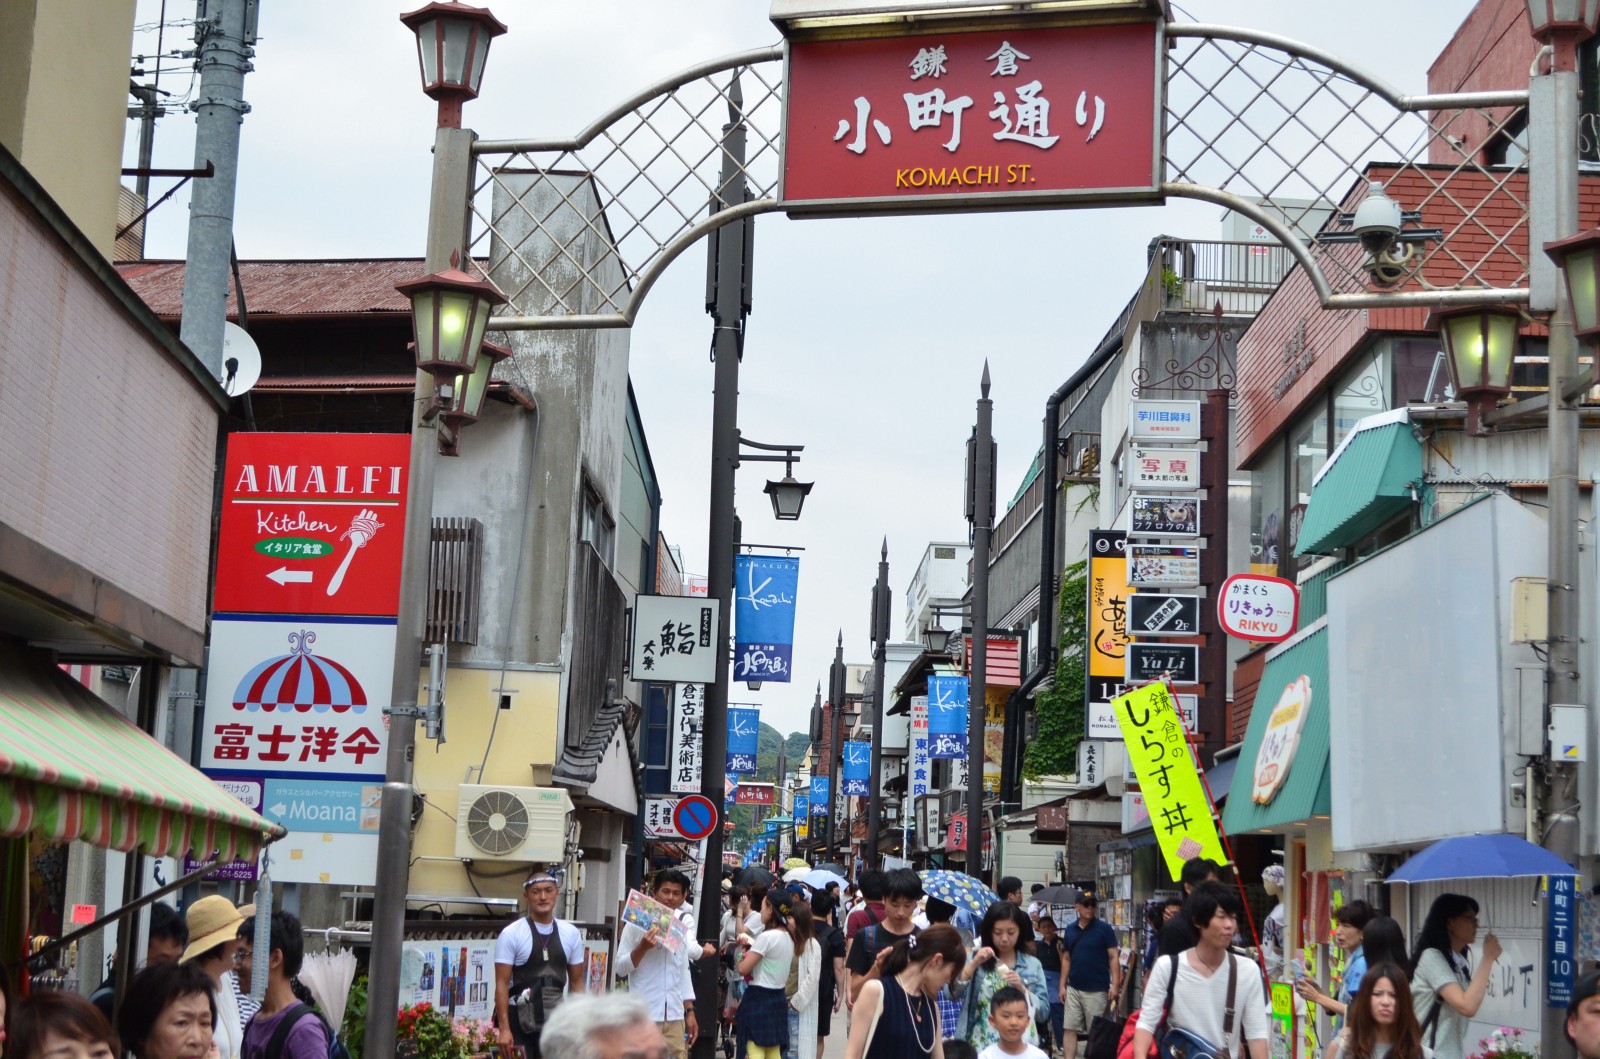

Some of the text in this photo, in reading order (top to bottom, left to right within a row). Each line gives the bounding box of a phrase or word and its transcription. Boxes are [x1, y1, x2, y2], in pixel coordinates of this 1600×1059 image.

[908, 41, 1031, 80] 鎌倉
[833, 80, 1106, 154] 小町通り
[896, 164, 1036, 188] KOMACHI ST.
[1136, 450, 1147, 459] 3F
[1142, 459, 1188, 473] 写真
[234, 465, 402, 494] AMALFI
[1134, 498, 1149, 509] 3F
[257, 509, 337, 535] Kitchen
[1135, 521, 1196, 532] フクロウの森
[264, 542, 322, 554] イタリア食堂
[1233, 583, 1268, 595] かまくら
[1229, 600, 1274, 618] りきゅう
[1174, 619, 1190, 631] 2F
[1238, 618, 1278, 633] RIKYU
[660, 619, 696, 657] 鮨
[1141, 656, 1186, 669] Yu Li
[1150, 690, 1184, 758] 鎌倉の
[914, 738, 928, 795] 東洋食肉
[1125, 699, 1193, 835] しらす丼
[276, 788, 360, 798] ガラスとシルバーアクセサリー
[289, 800, 356, 821] Moana
[650, 803, 659, 826] オオキ
[662, 808, 671, 825] 理容
[953, 820, 963, 846] コロッケ
[1554, 878, 1568, 954] 小町二丁目
[1551, 959, 1570, 975] 10
